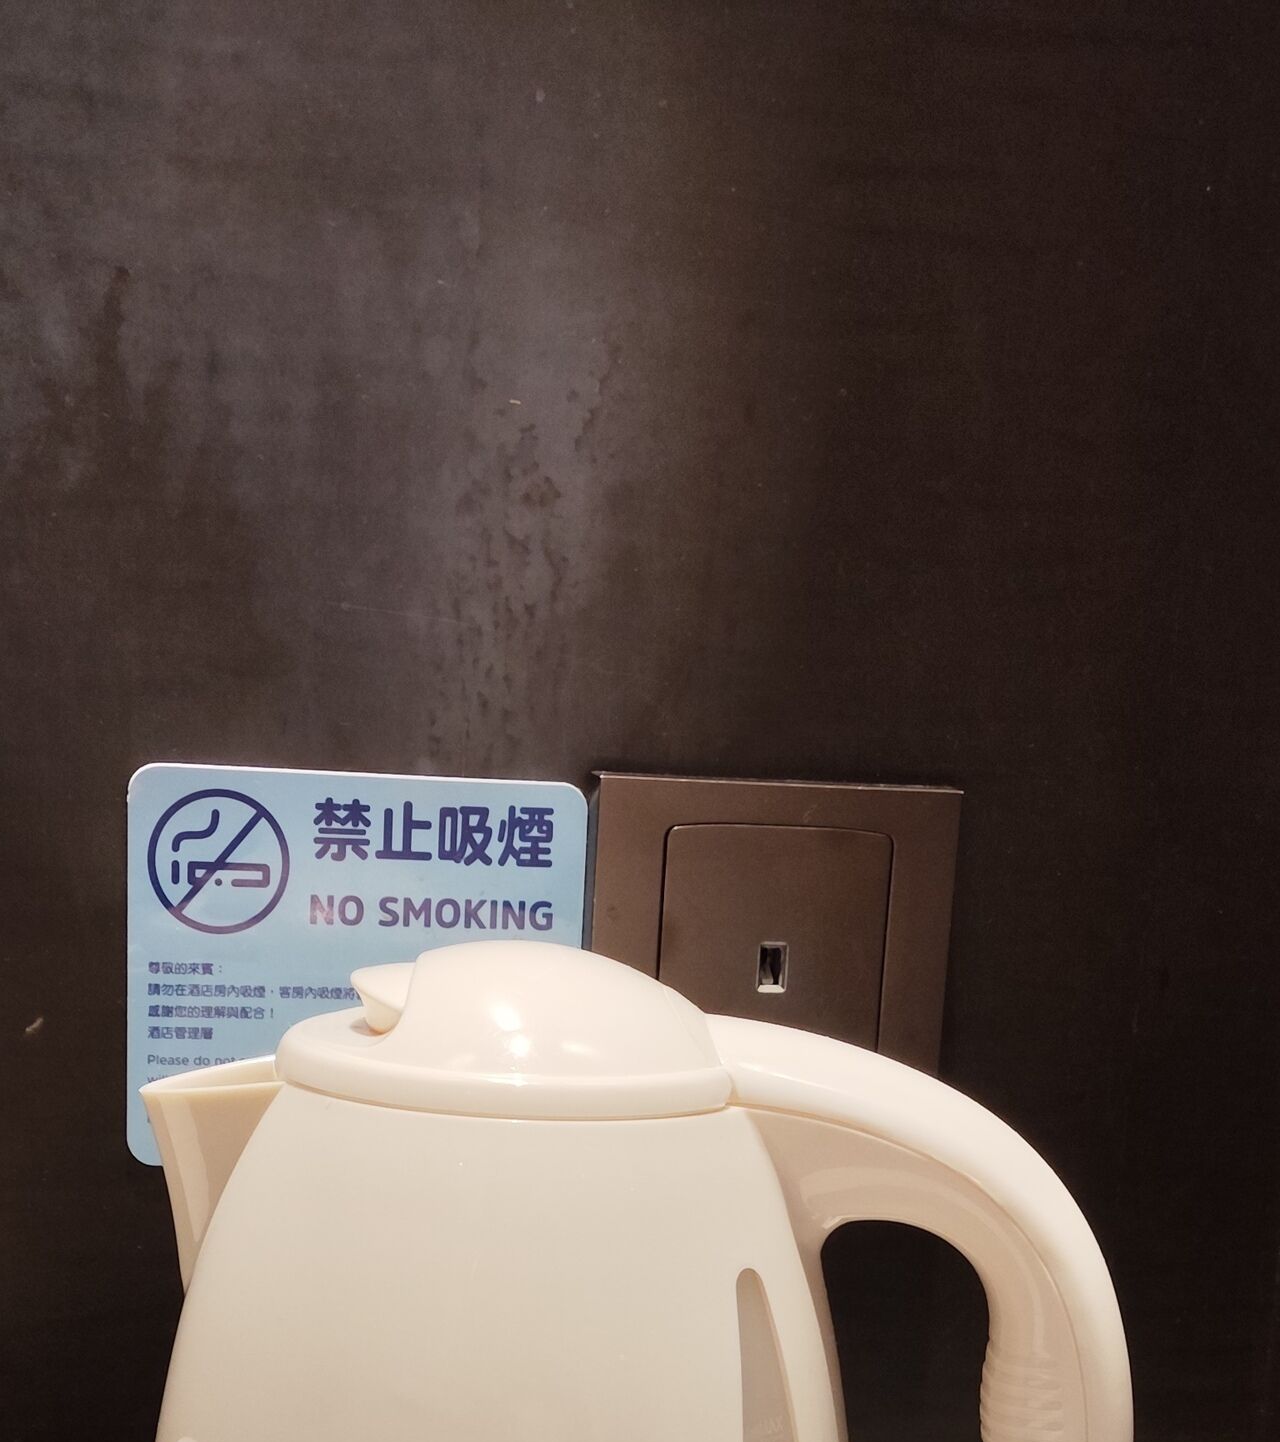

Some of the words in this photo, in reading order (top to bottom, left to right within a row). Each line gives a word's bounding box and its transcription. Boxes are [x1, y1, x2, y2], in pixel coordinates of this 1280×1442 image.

[313, 796, 555, 868] 禁止吸煙
[309, 894, 365, 927] NO
[378, 896, 553, 931] SMOKING
[147, 1054, 189, 1066] Please
[194, 1055, 210, 1067] do
